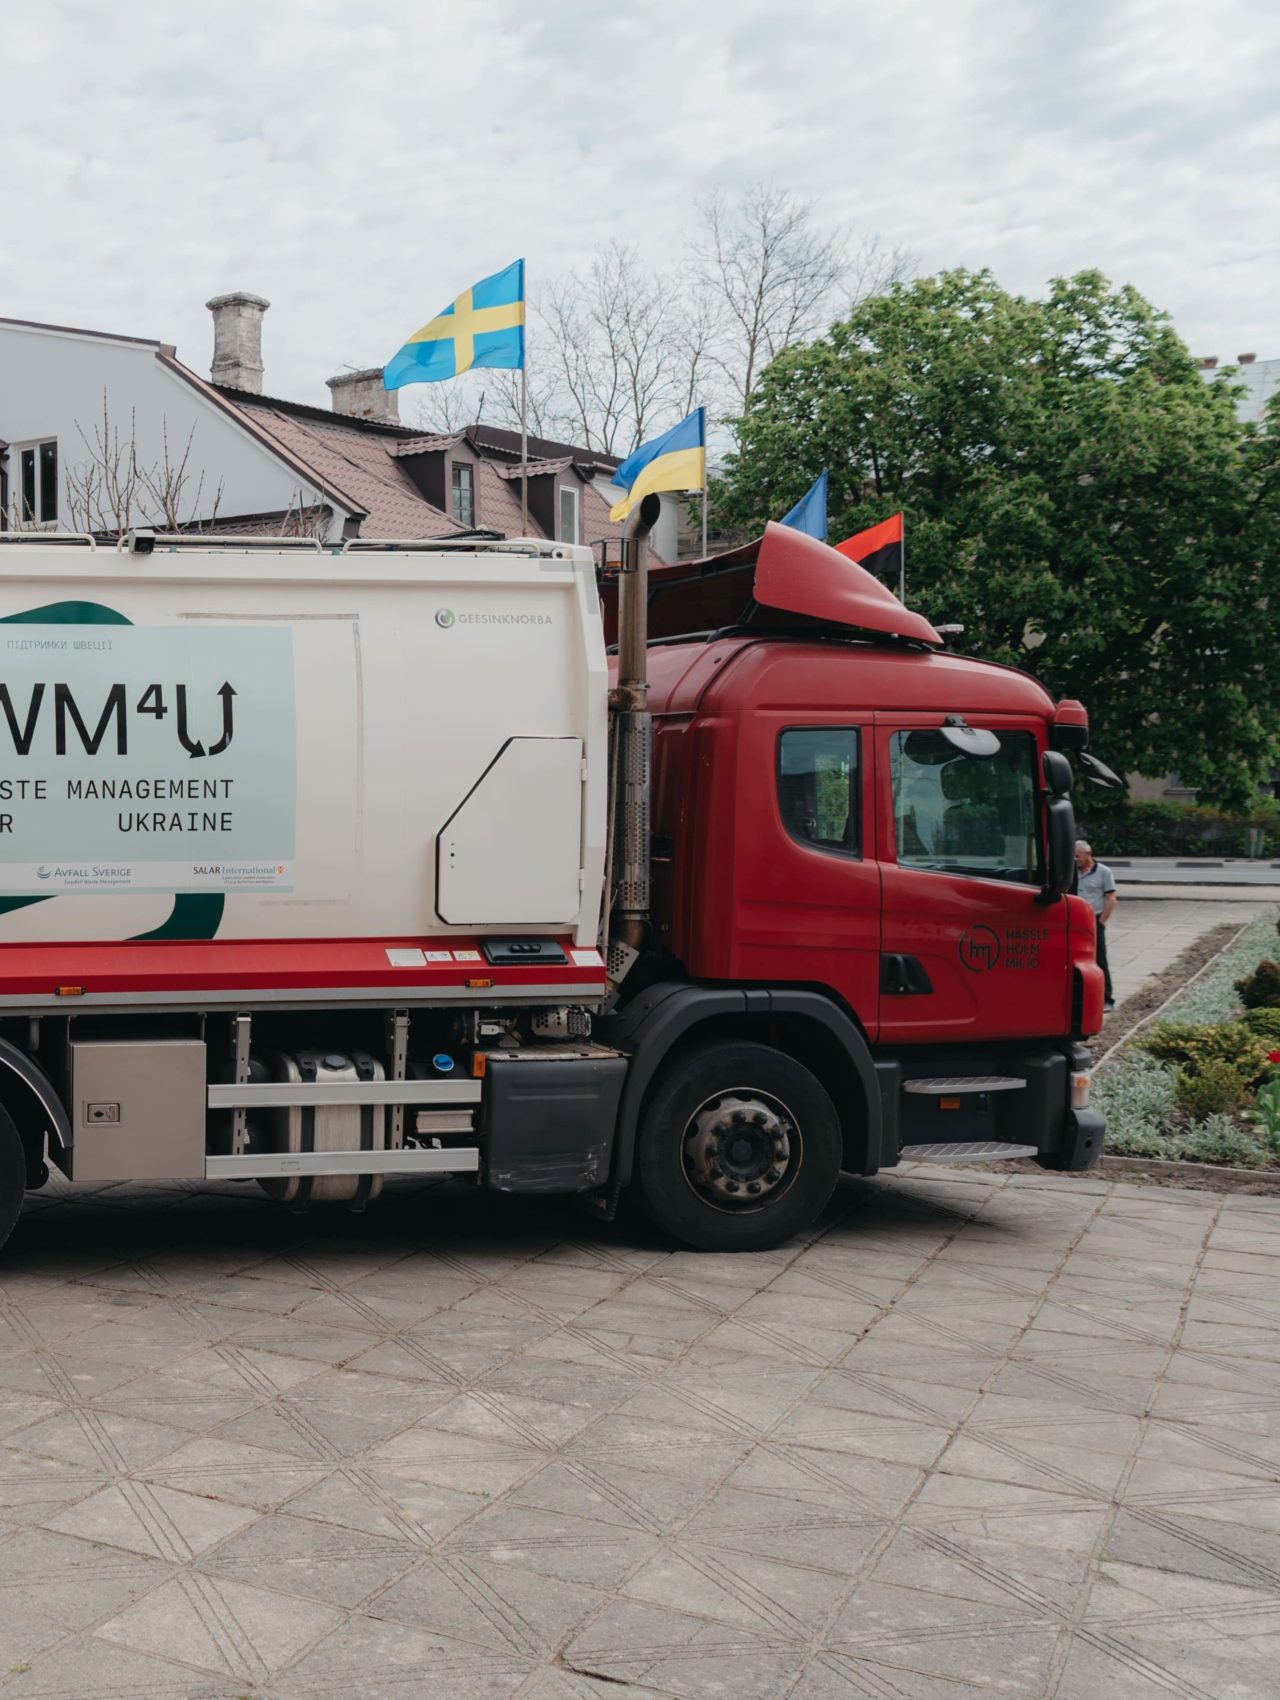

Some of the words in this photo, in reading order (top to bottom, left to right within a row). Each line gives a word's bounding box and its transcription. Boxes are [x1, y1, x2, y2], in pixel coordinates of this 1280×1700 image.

[458, 614, 553, 625] GEESINKNORBA
[7, 640, 68, 651] ПІДТРИМКИ
[73, 640, 113, 651] ШВЕЦІЇ
[67, 779, 234, 799] MANAGEMENT
[118, 812, 233, 832] UKRAINE
[193, 866, 220, 875] SALAR
[222, 866, 276, 875] International
[1006, 943, 1040, 955] HOLM
